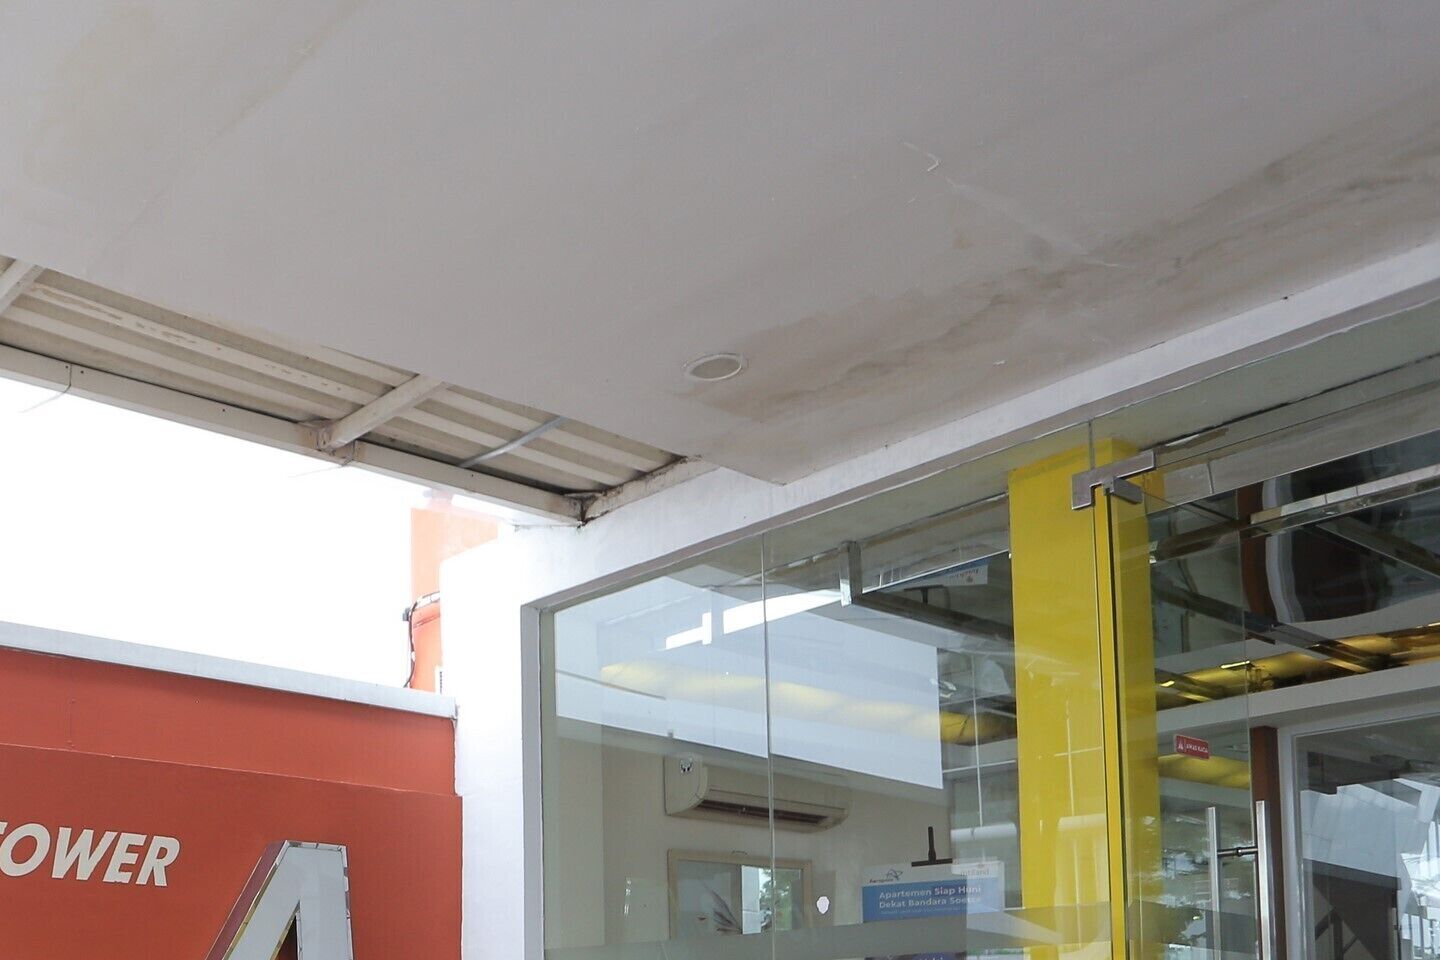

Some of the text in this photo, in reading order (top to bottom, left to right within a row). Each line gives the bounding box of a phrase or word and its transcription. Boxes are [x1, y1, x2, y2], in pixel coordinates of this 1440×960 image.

[879, 886, 981, 900] Apartemen Siap Huni
[879, 900, 906, 908] Dekat
[908, 898, 947, 907] Bandara
